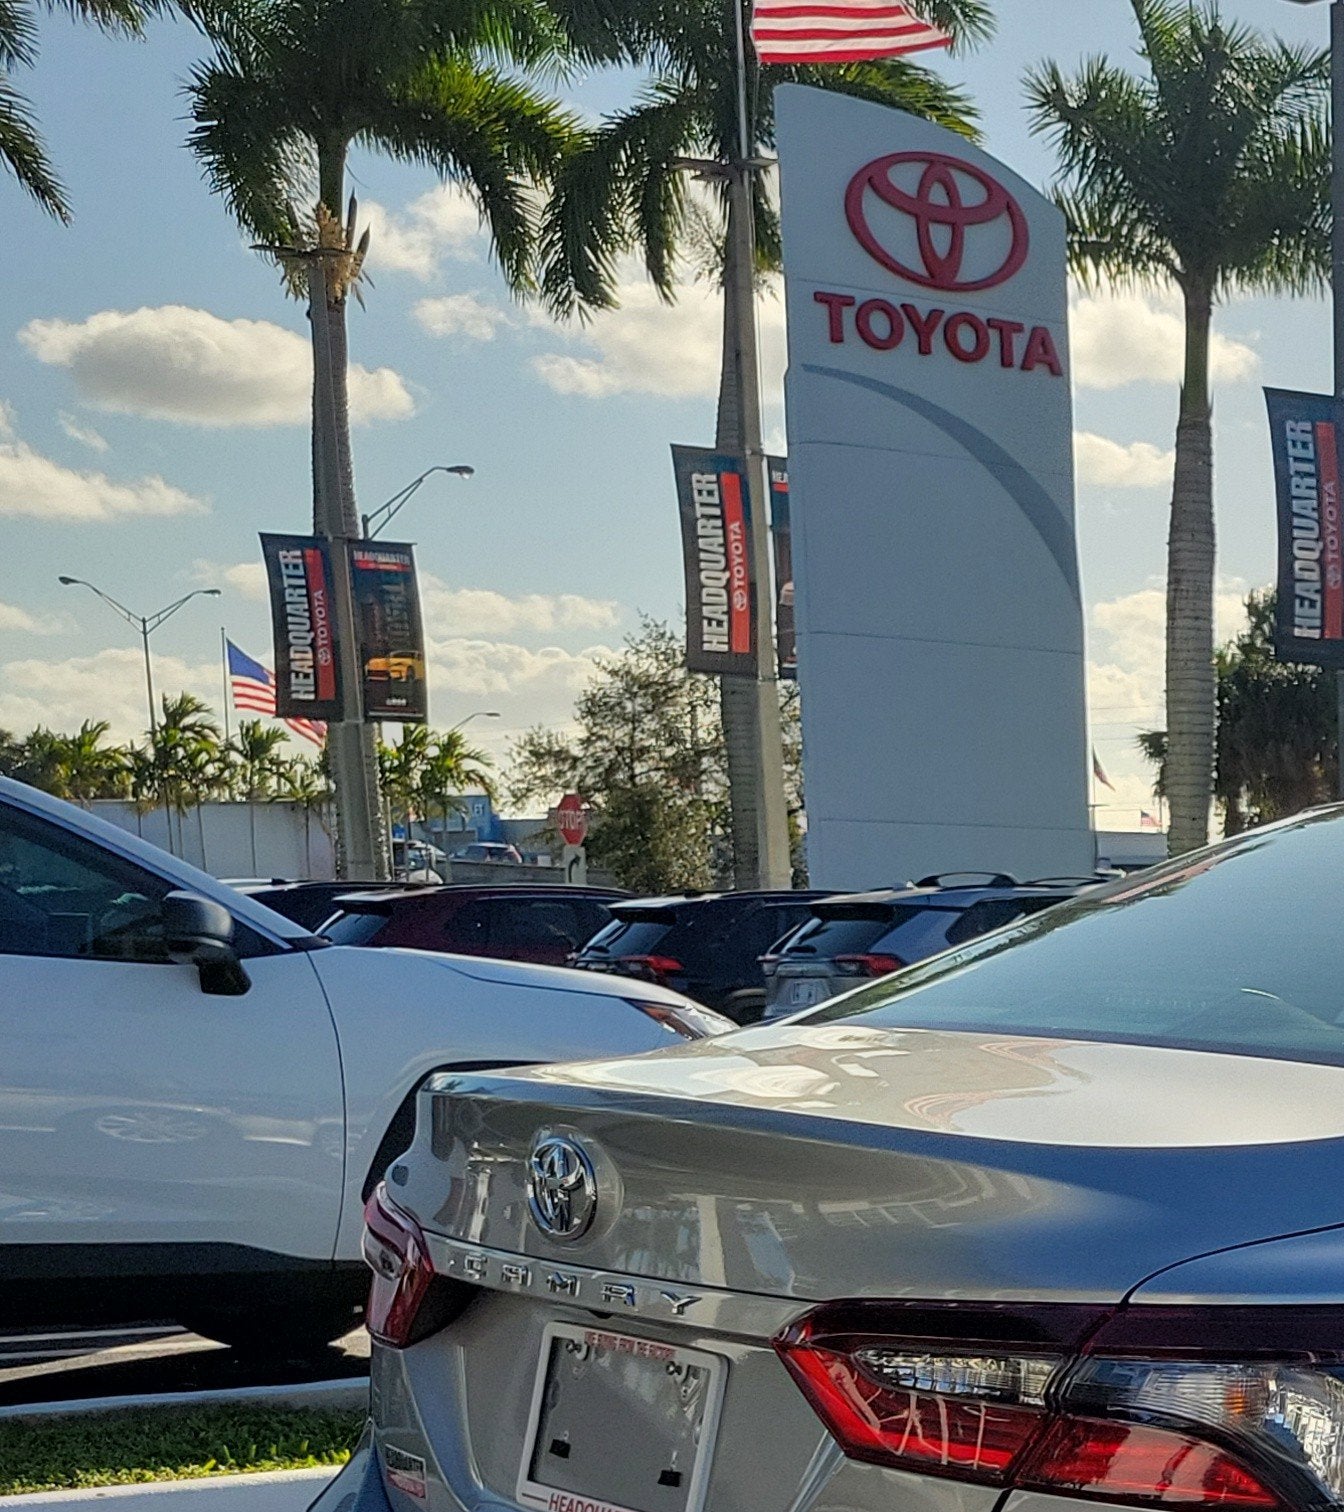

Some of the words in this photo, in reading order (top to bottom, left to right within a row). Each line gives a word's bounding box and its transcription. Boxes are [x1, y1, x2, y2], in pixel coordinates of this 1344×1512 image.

[813, 291, 1063, 376] TOYOTA
[729, 521, 745, 588] TOYOTA
[1286, 420, 1323, 639] HEADQUARTER
[1323, 480, 1341, 560] TOYOTA
[692, 472, 731, 652] HEADQUARTER
[278, 550, 316, 700] HEADQUARTER
[313, 590, 330, 646] TOYOTA
[559, 810, 586, 829] STOP
[464, 1251, 702, 1317] CAMRY
